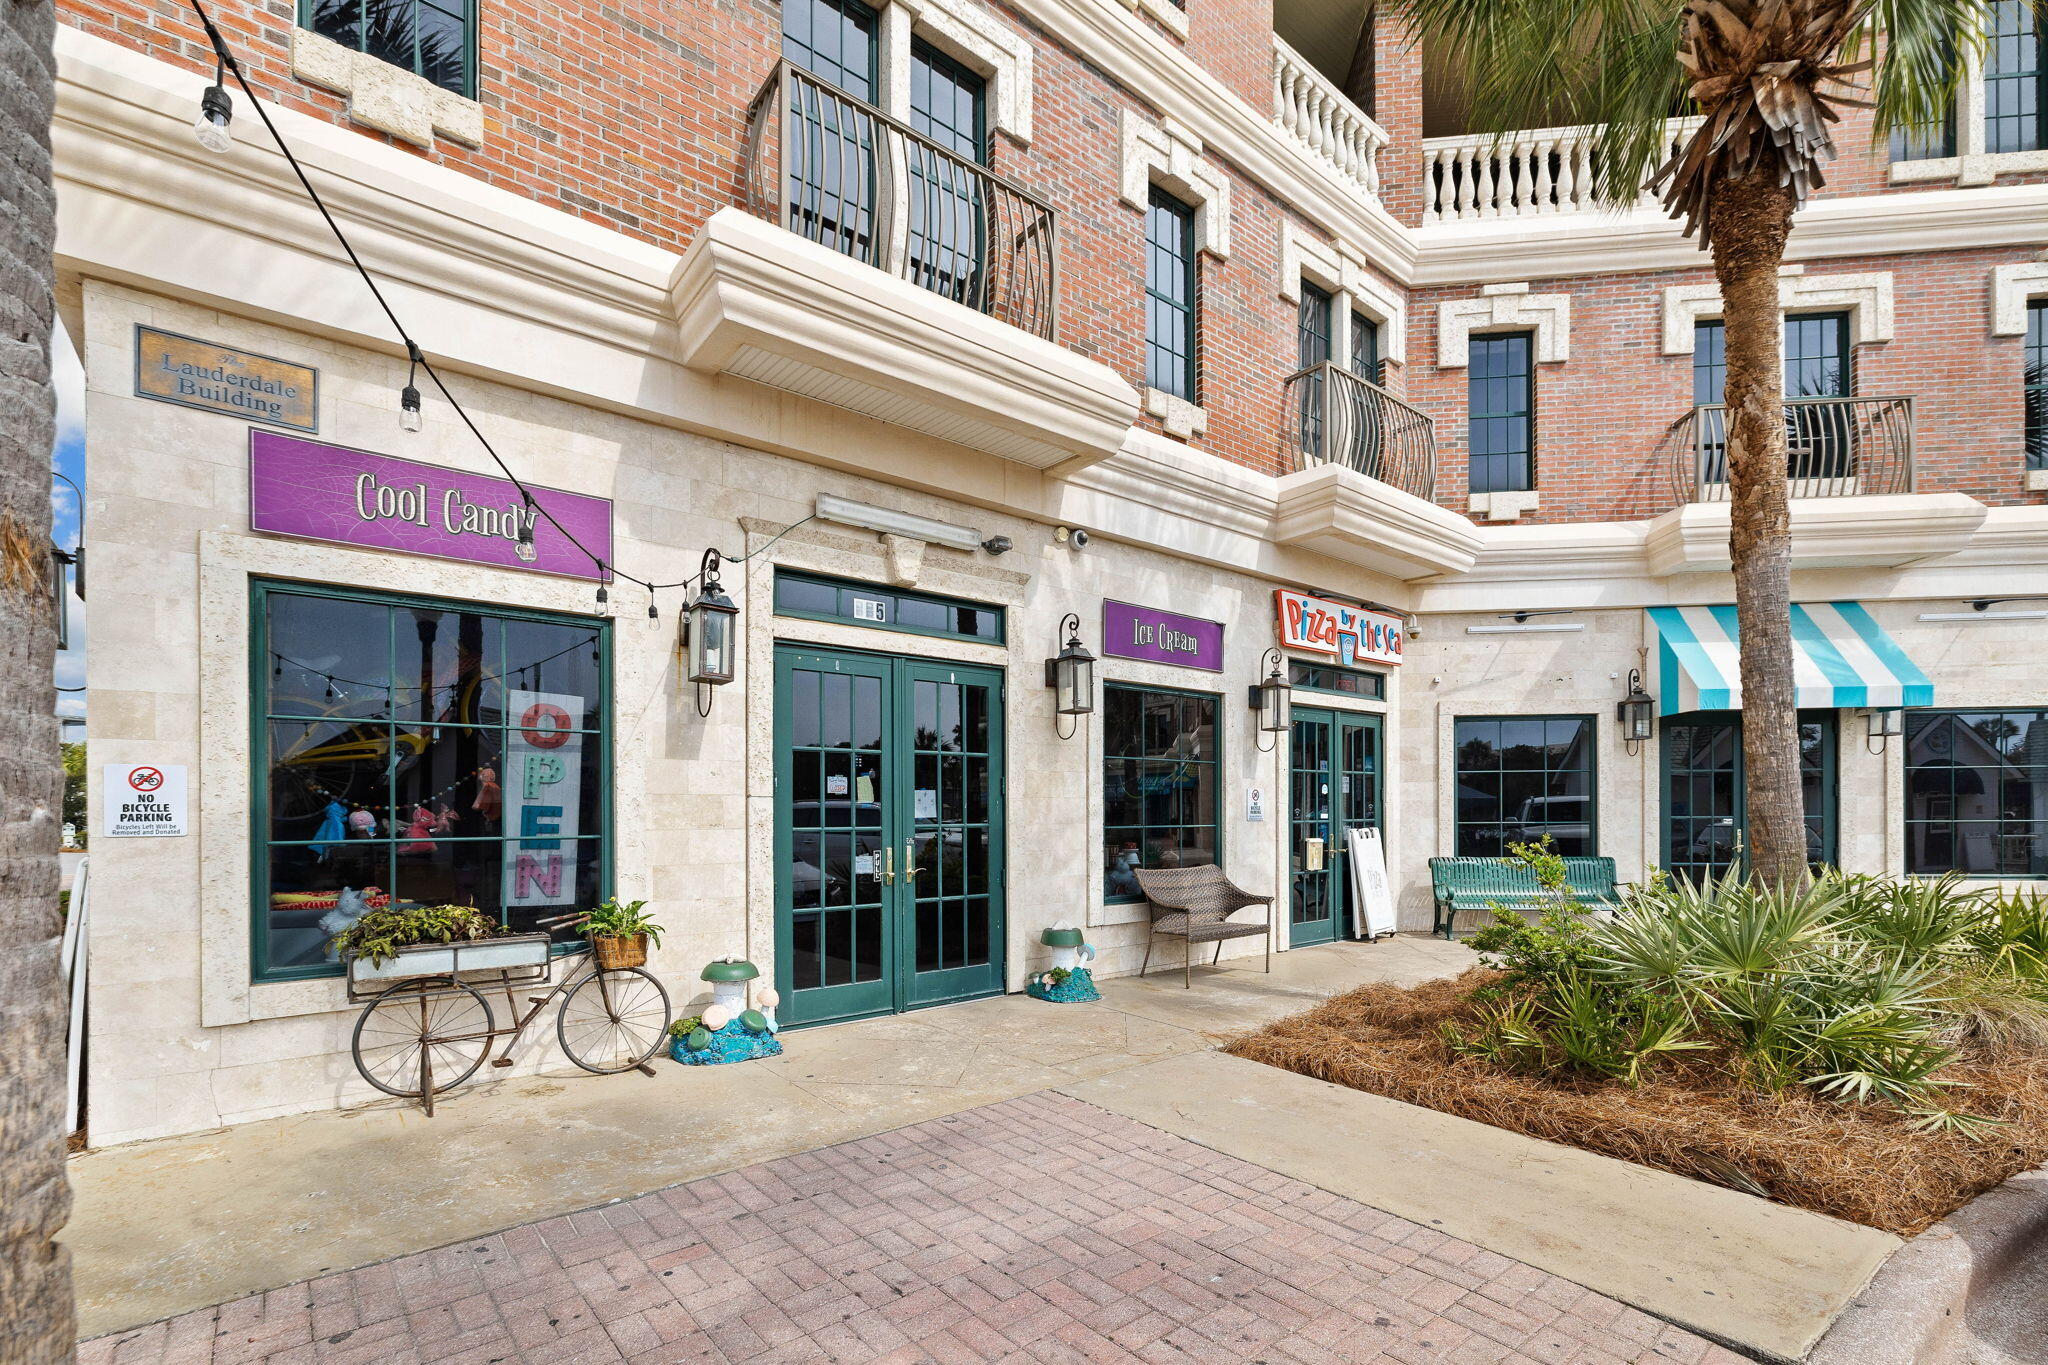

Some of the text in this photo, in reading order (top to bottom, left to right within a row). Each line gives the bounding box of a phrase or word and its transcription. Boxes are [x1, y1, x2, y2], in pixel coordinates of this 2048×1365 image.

[161, 353, 297, 398] Lauderdale
[178, 377, 283, 418] Building
[356, 473, 429, 528] Cool
[1286, 598, 1337, 646] Pizza
[1341, 609, 1356, 629] by
[120, 813, 173, 822] PARKING
[122, 803, 170, 813] BICYCLE
[138, 794, 155, 803] NO
[514, 703, 571, 898] OPEN
